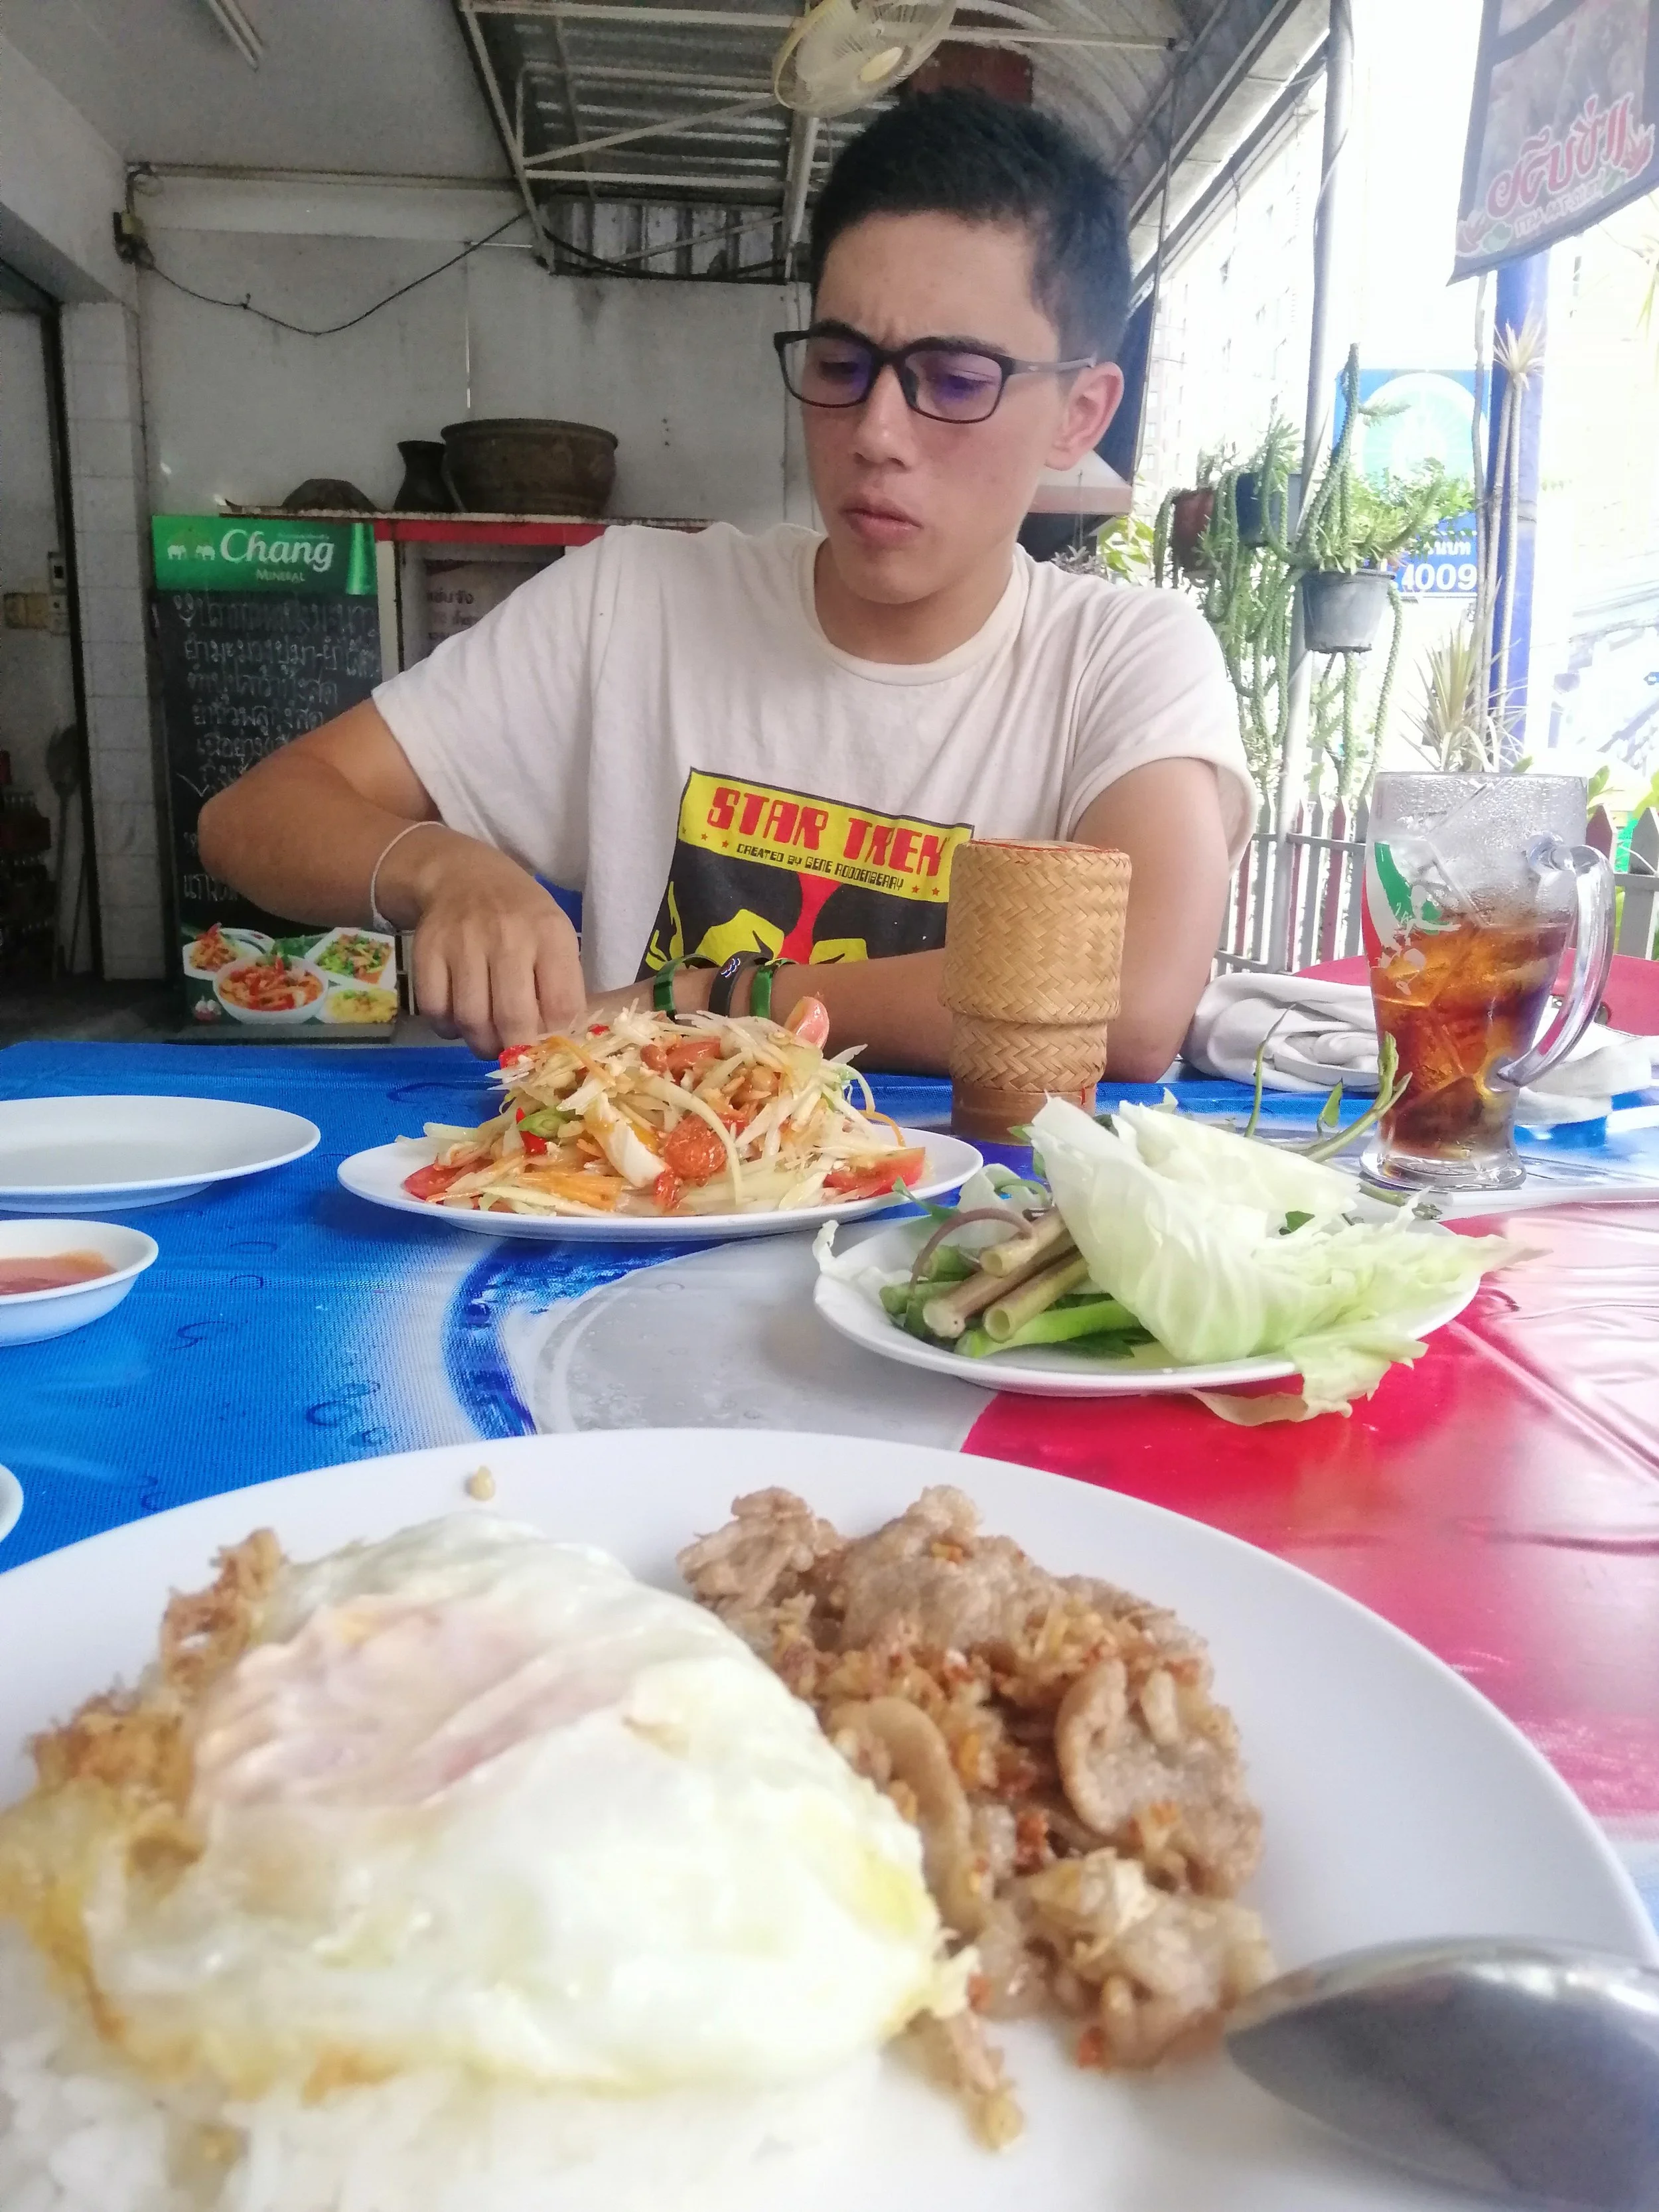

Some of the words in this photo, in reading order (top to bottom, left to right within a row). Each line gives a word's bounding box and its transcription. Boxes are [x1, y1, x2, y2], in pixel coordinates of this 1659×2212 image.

[220, 529, 334, 572] Chang
[707, 786, 829, 850] STAR
[844, 817, 949, 877] TREK
[737, 843, 784, 862] CREATED
[788, 854, 802, 865] BY
[805, 855, 833, 873] GENE
[834, 861, 904, 891] RODDENBERRY
